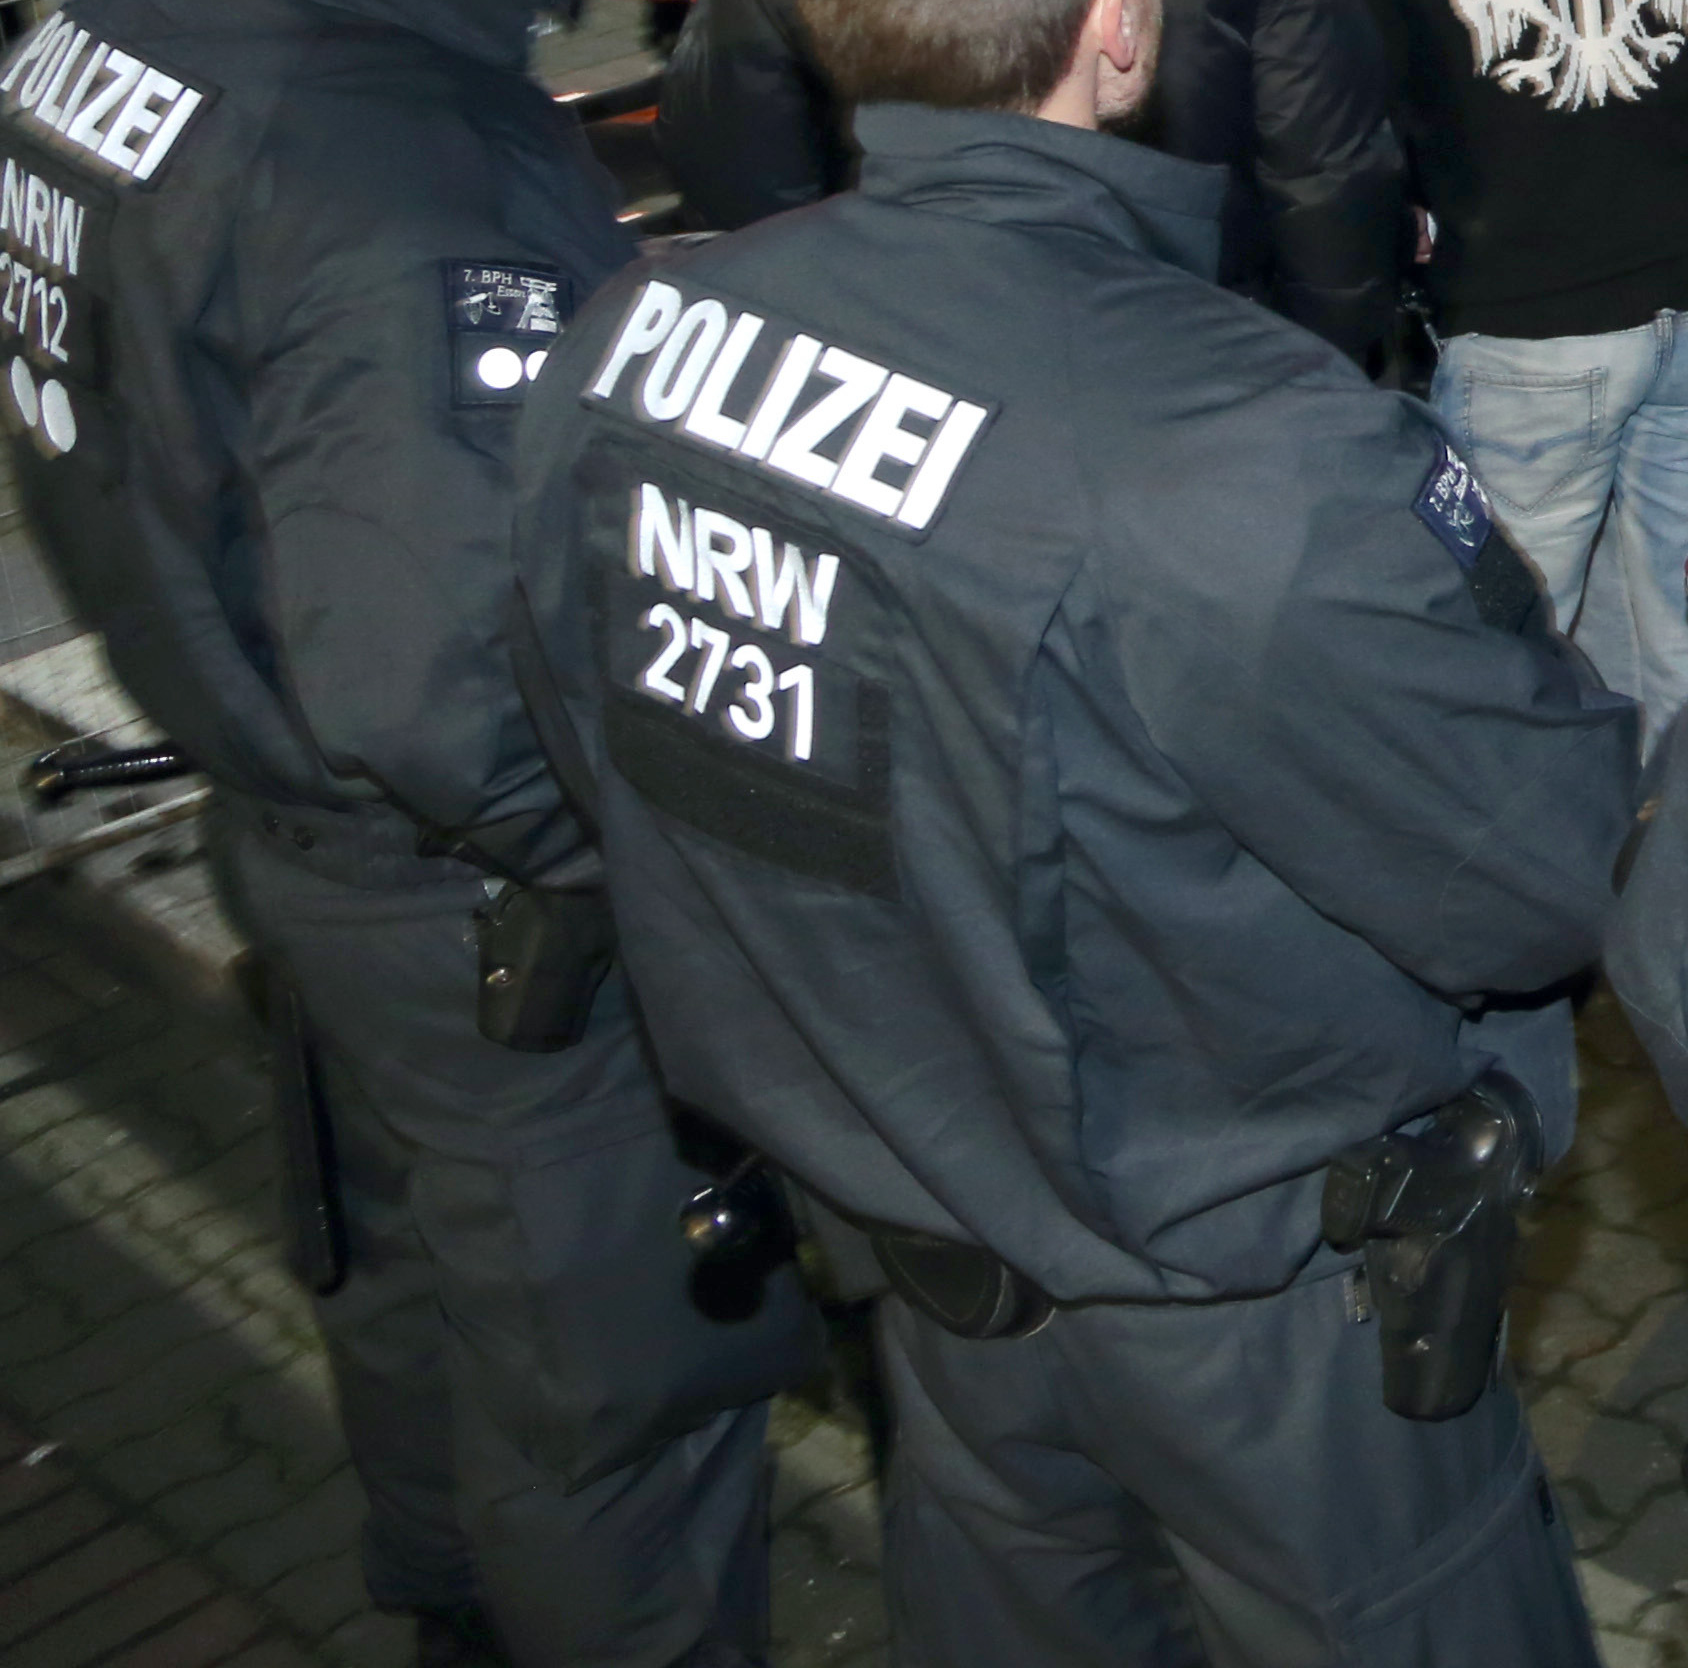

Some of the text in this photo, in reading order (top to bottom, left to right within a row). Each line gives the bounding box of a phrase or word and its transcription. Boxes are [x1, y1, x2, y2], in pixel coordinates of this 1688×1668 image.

[1, 11, 203, 181] POLIZEI
[1, 158, 85, 276] NRW
[481, 270, 513, 285] BPH
[0, 252, 70, 363] 2712
[590, 280, 989, 531] POLIZEI
[634, 483, 840, 646] NRW
[641, 603, 815, 761] 2731
